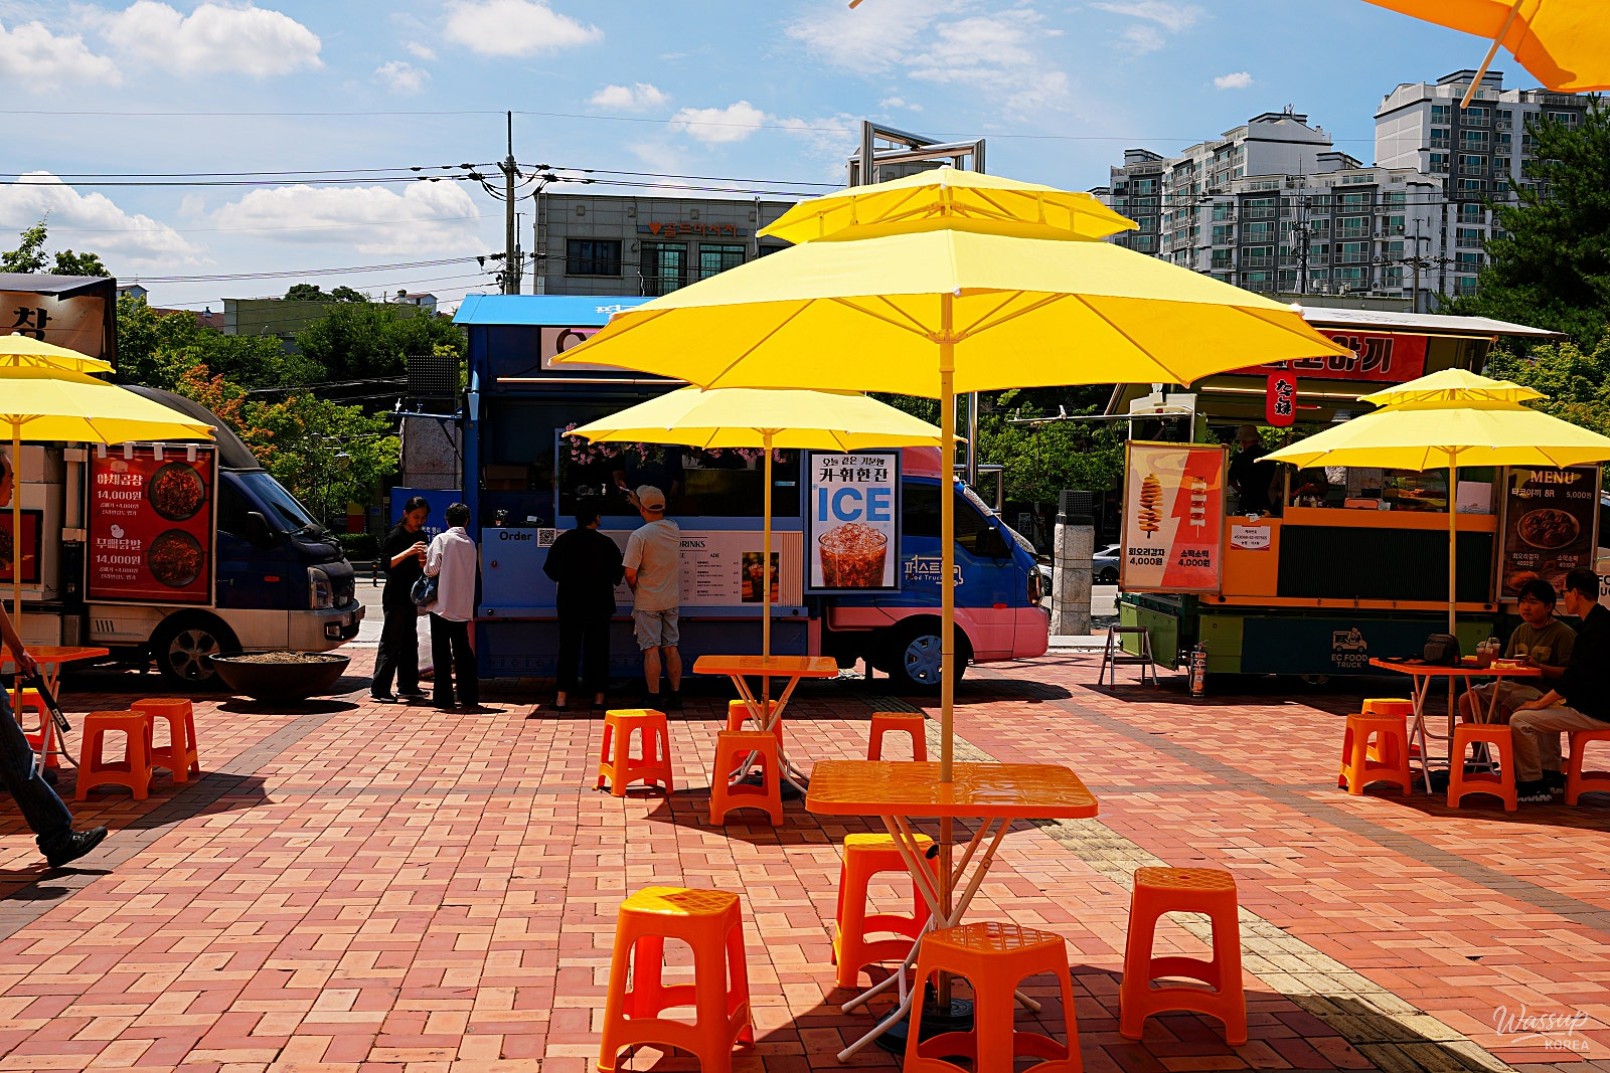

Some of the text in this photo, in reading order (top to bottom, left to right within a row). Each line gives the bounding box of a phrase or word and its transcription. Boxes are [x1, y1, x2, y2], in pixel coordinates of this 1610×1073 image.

[664, 222, 737, 238] 골드마사지
[823, 458, 839, 467] 오늘
[842, 456, 857, 465] 같은
[97, 473, 143, 486] 야채곱창
[1530, 470, 1575, 484] MENU
[819, 487, 891, 521] ICE
[499, 531, 533, 541] Order
[1128, 547, 1165, 557] 회오리감자
[904, 554, 942, 574] 퍼스트
[1129, 557, 1163, 566] 4,000원
[1178, 558, 1211, 568] 4,000원
[1331, 653, 1368, 662] EC FOOD
